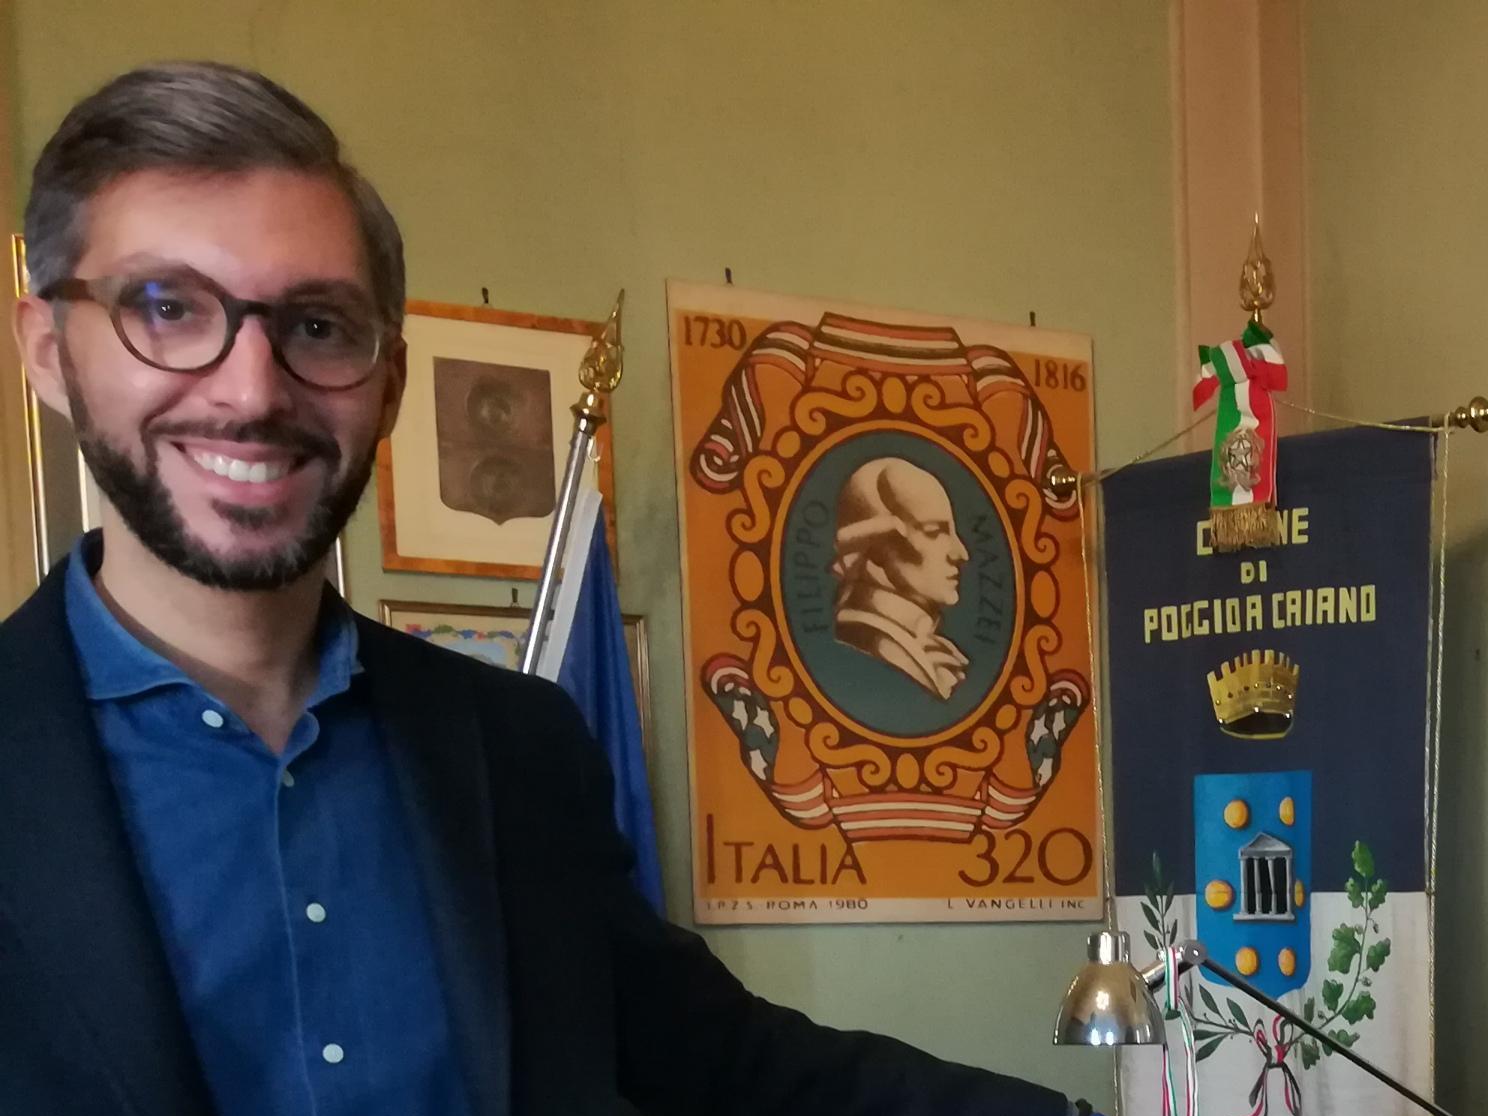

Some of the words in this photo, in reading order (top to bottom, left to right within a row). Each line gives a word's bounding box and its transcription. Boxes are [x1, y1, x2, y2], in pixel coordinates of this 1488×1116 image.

[684, 315, 747, 351] 1730
[1034, 358, 1087, 392] 1816
[794, 500, 830, 634] FILIPPO
[1241, 560, 1267, 584] DI
[1144, 598, 1241, 644] POGGIO
[1246, 594, 1263, 632] A
[1272, 585, 1376, 629] CAIANO
[707, 814, 867, 885] ITALIA
[958, 827, 1093, 887] 320
[766, 900, 818, 911] ROMA
